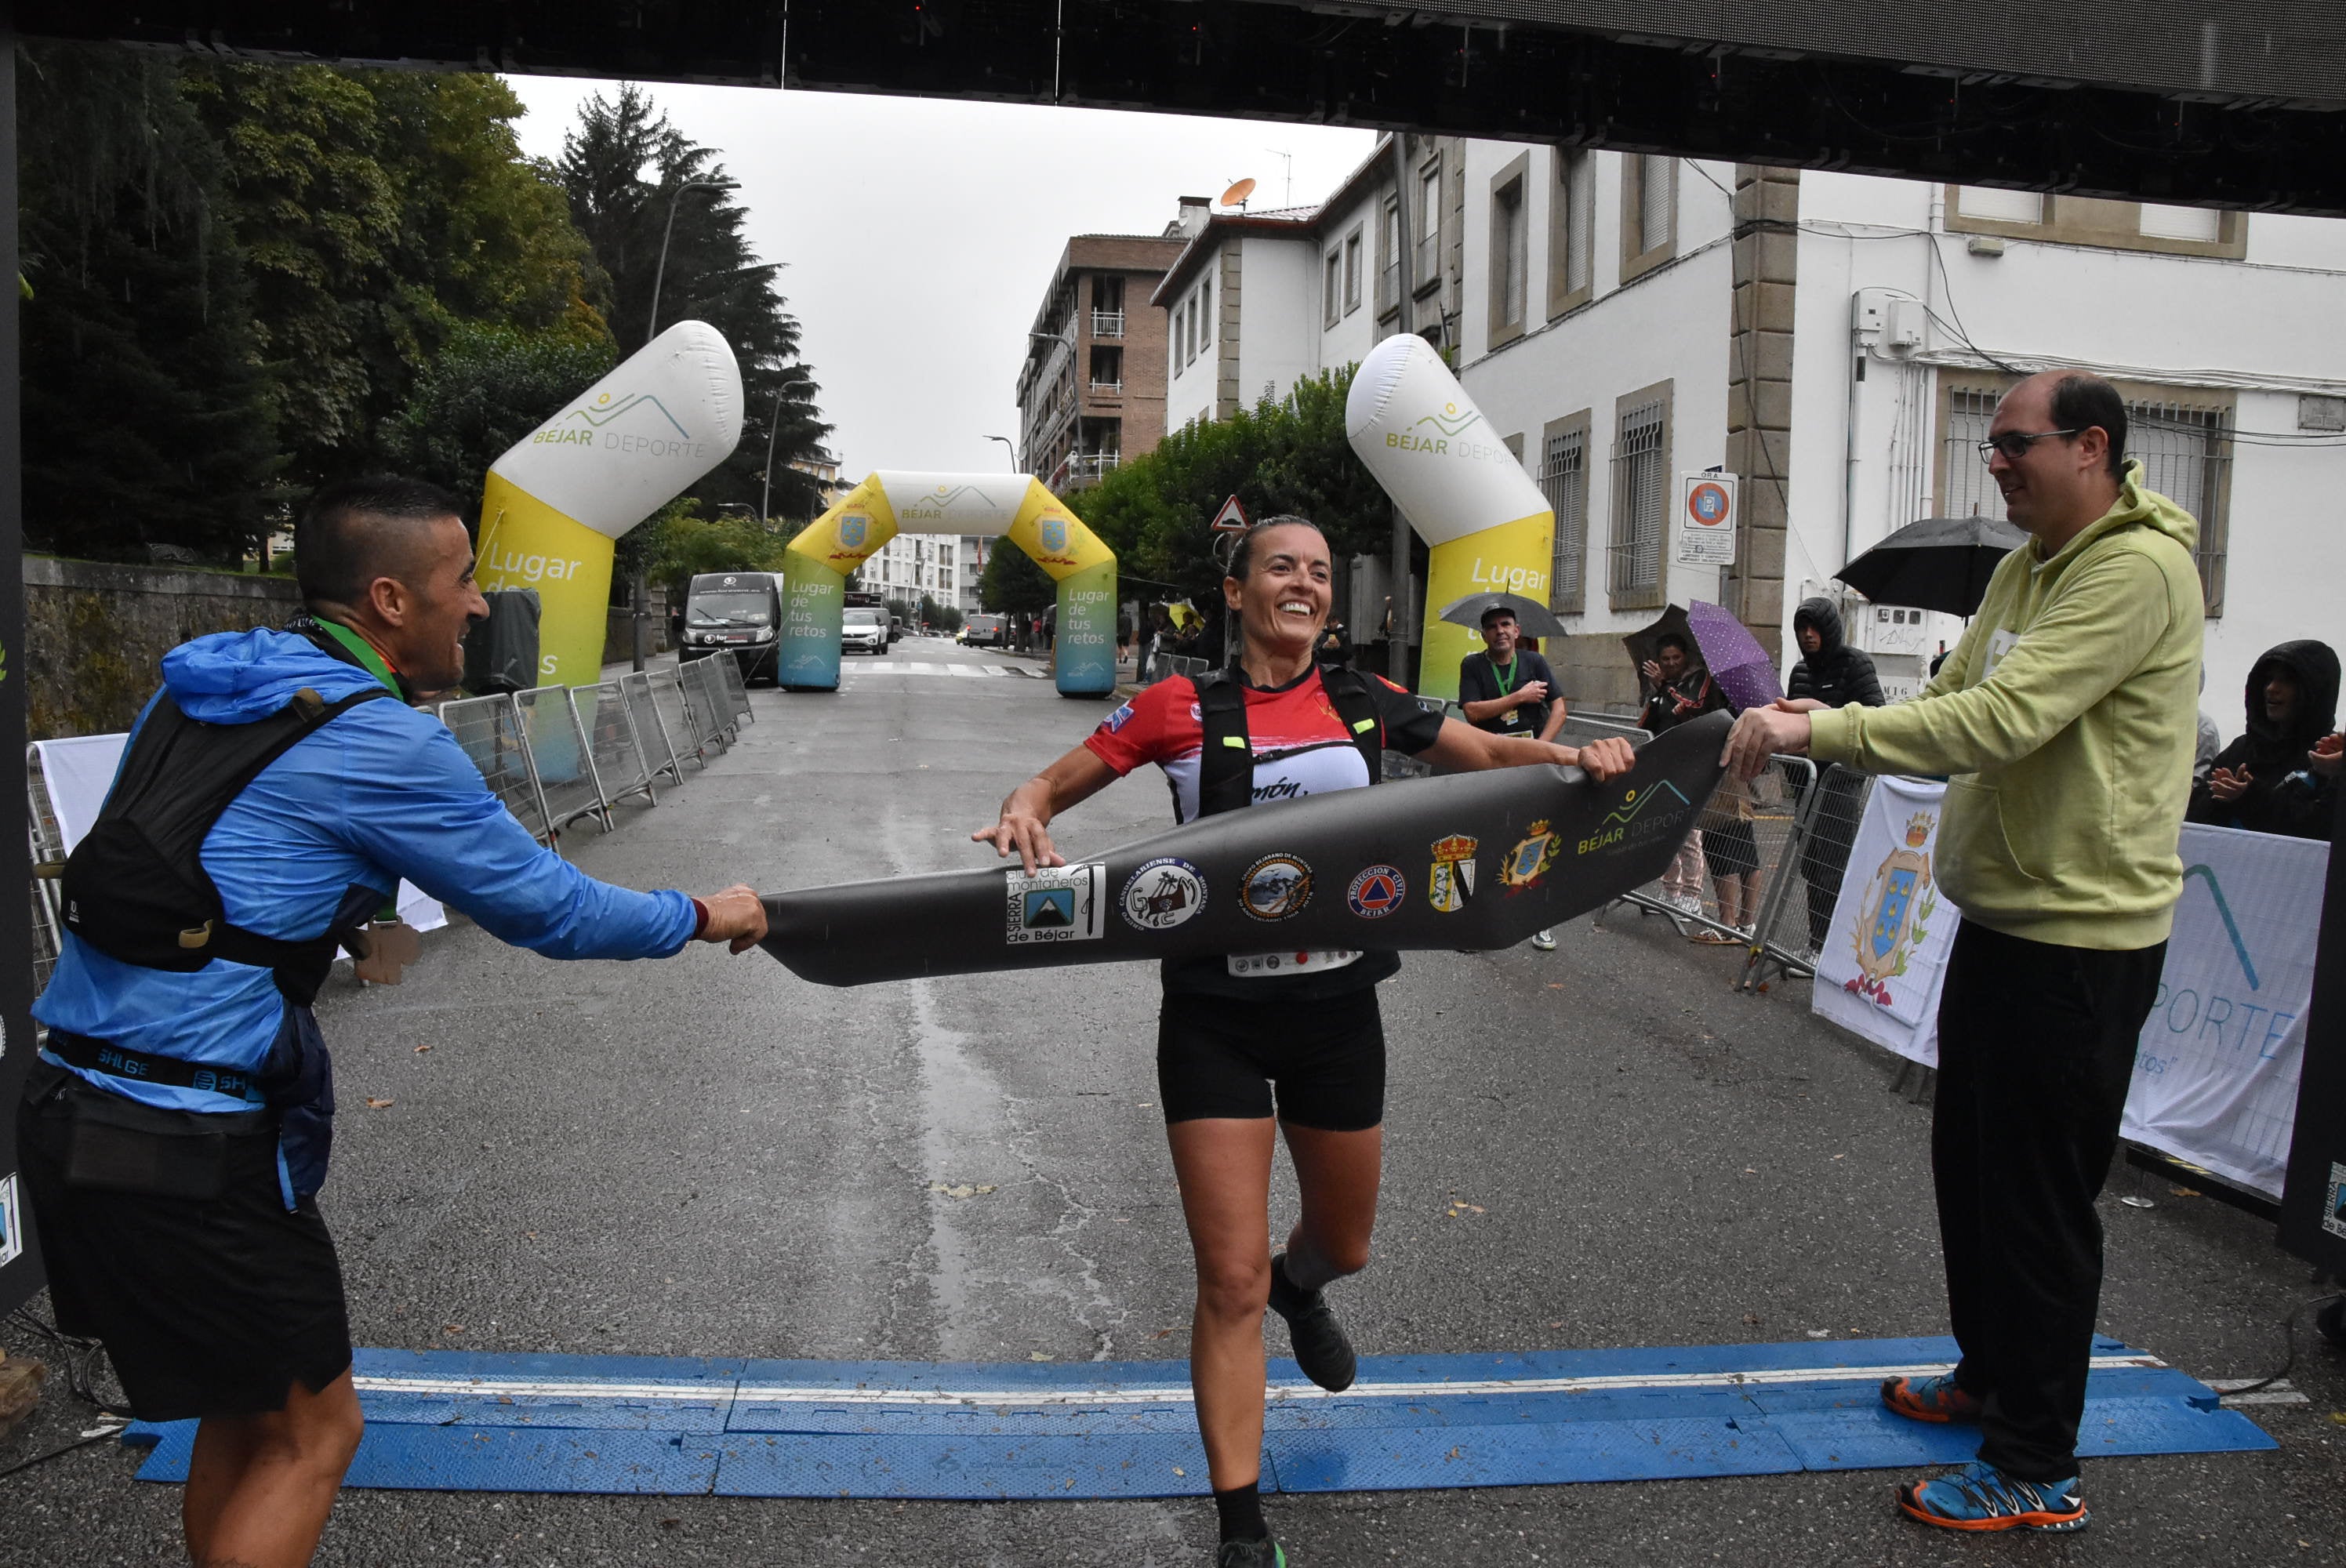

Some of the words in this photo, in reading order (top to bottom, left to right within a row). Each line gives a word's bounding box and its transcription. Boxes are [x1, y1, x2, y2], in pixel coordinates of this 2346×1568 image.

[532, 422, 594, 446] BÉJAR
[605, 432, 706, 458] DEPORTE
[1386, 426, 1448, 455] BÉJAR
[902, 503, 942, 520] BÉJAR
[488, 542, 582, 583] Lugar
[1471, 557, 1547, 592] Lugar
[791, 579, 834, 597] Lugar
[790, 593, 809, 608] de
[1069, 588, 1110, 604] Lugar
[790, 608, 813, 622] tus
[1069, 602, 1087, 615] de
[1069, 617, 1091, 630] tus
[790, 624, 827, 639] retos
[1068, 632, 1105, 644] retos
[1578, 827, 1625, 855] BÉJAR
[1255, 852, 1284, 866] BEJARANO
[1006, 870, 1029, 880] clu
[1040, 868, 1059, 878] de
[1182, 861, 1197, 873] DE
[1392, 873, 1404, 898] CIVIL
[1007, 891, 1022, 932] SIERRA
[1007, 932, 1030, 942] de
[1034, 929, 1075, 942] Béjar
[2325, 1181, 2337, 1218] SIERRA
[2322, 1219, 2336, 1231] de
